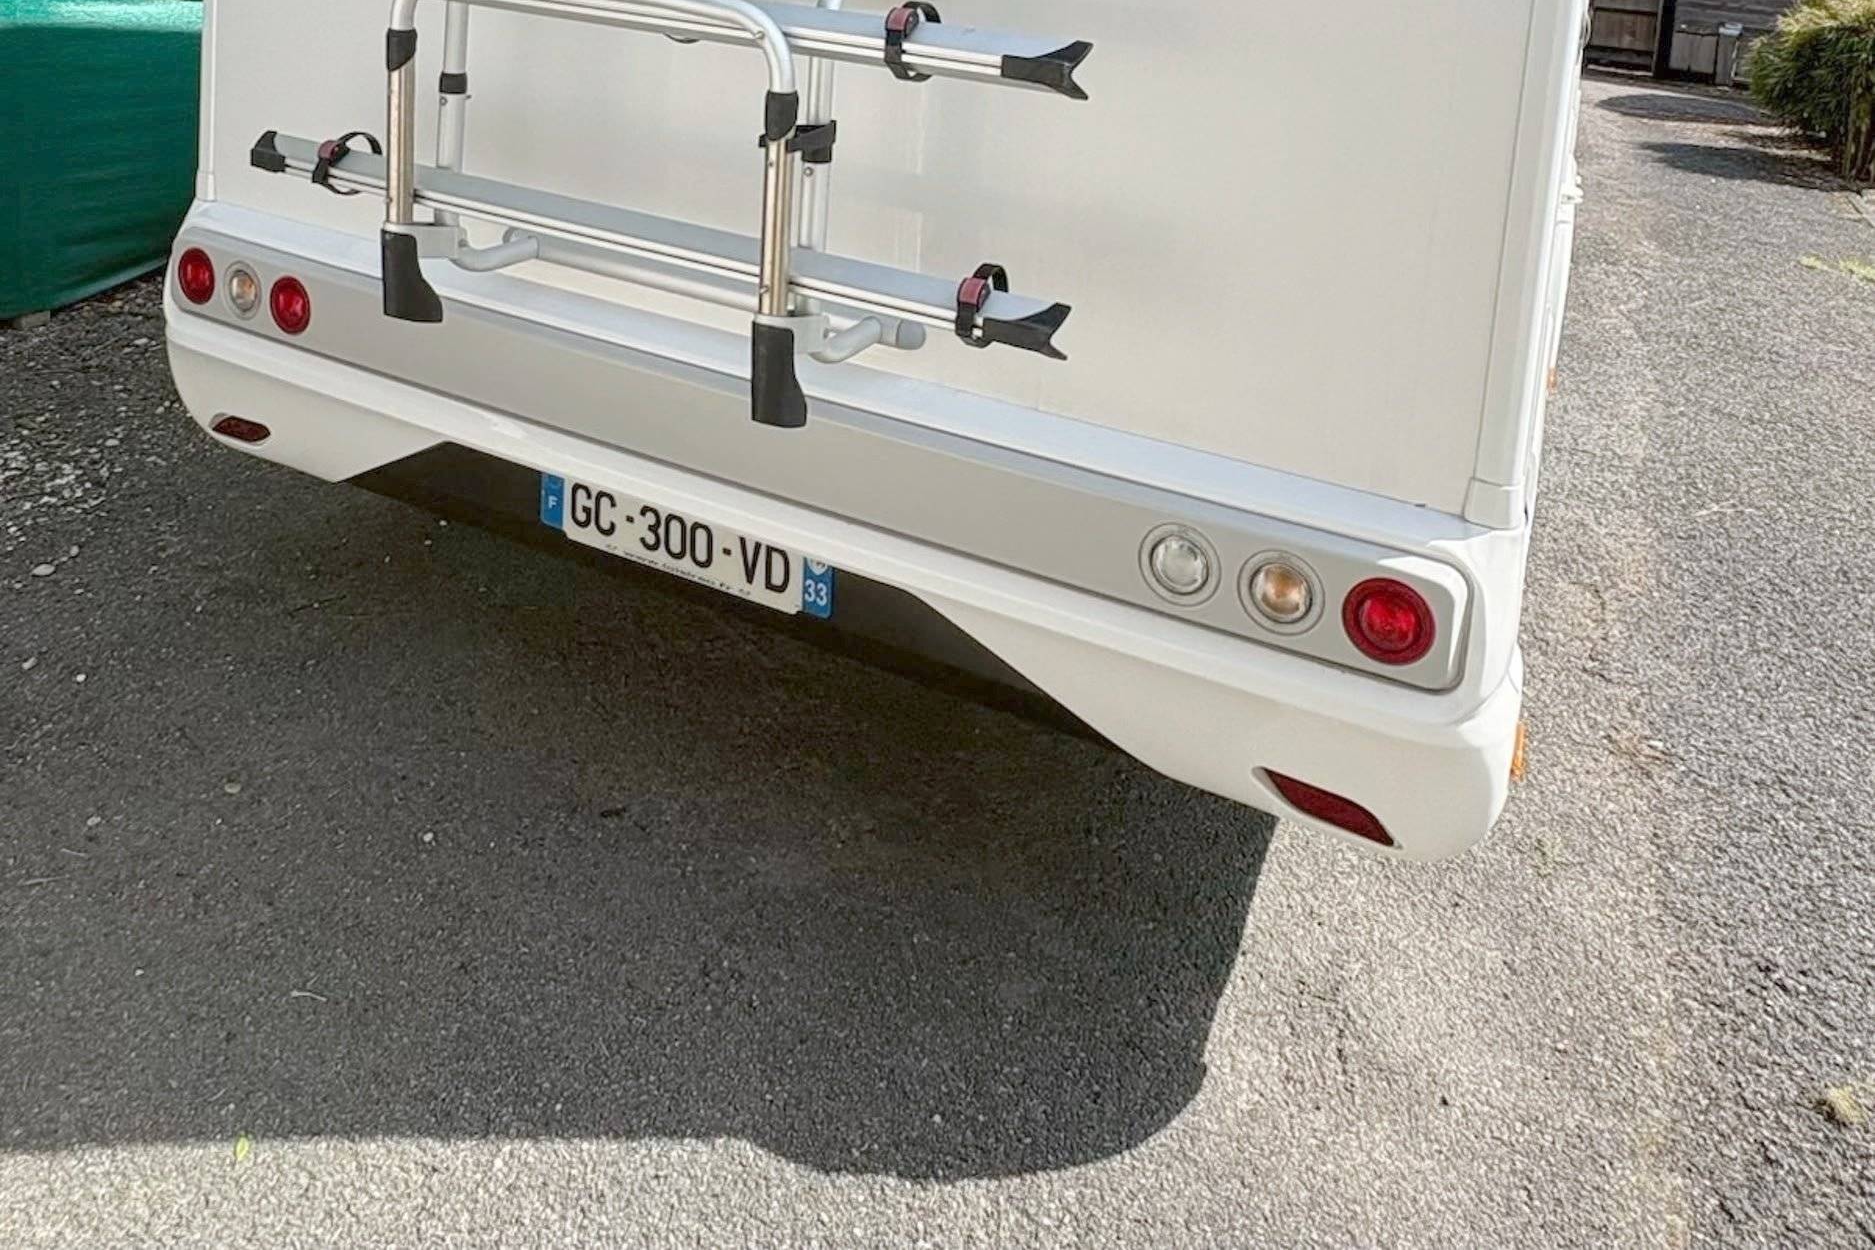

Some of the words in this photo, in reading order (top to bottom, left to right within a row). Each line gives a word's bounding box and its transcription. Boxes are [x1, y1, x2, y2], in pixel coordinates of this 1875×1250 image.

[548, 494, 557, 510] F
[571, 482, 790, 593] GC-300-VD
[804, 579, 827, 606] 33
